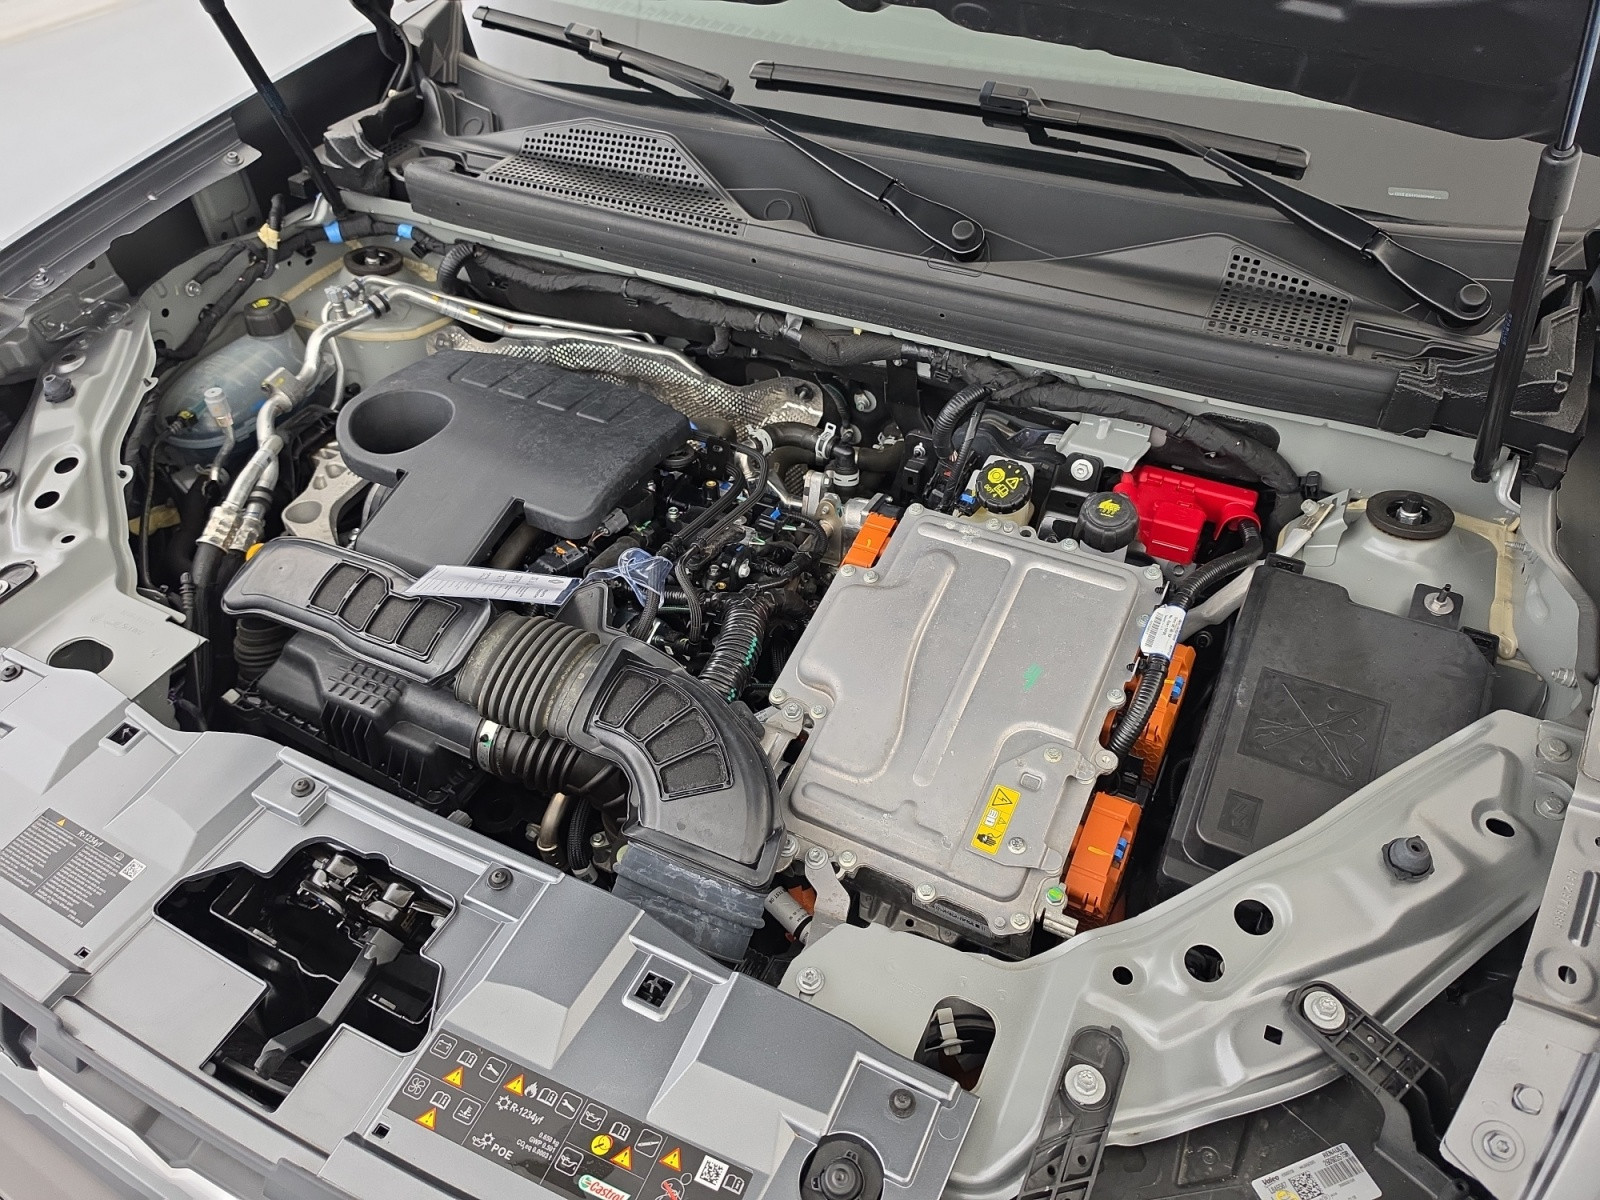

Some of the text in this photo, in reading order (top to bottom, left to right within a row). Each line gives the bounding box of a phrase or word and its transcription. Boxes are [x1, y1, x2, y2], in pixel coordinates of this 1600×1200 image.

[984, 484, 994, 494] DOT
[77, 829, 104, 848] R-1234yf
[509, 1103, 545, 1125] R-1234yf
[529, 1136, 542, 1147] GWP
[490, 1143, 514, 1161] POE
[1322, 1145, 1344, 1158] RENAULT
[589, 1181, 625, 1200] Castrol
